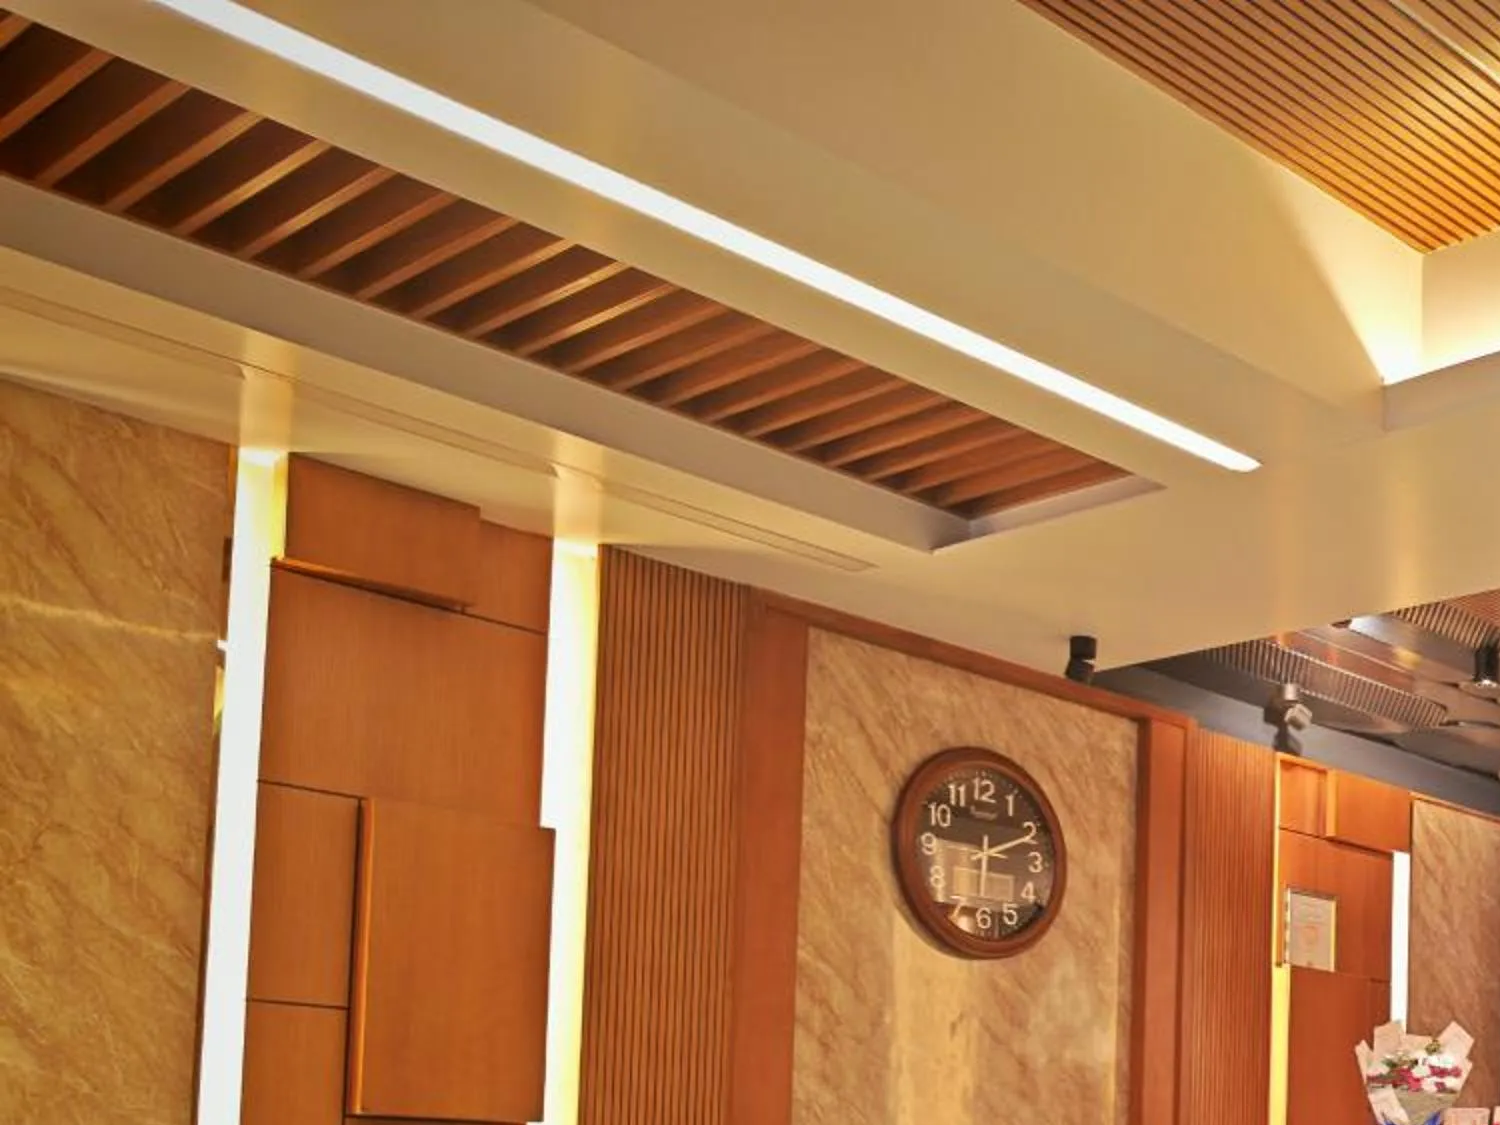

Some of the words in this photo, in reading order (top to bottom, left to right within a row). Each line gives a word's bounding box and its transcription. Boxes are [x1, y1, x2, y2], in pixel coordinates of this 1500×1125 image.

[948, 783, 967, 808] 11
[972, 776, 996, 804] 12
[928, 802, 951, 827] 10
[1005, 793, 1016, 817] 1
[921, 832, 937, 855] 9
[1022, 821, 1038, 844] 2
[1028, 851, 1043, 873] 3
[930, 865, 945, 888] 8
[1020, 880, 1036, 903] 4
[950, 894, 966, 919] 7
[975, 907, 992, 929] 6
[1002, 903, 1018, 925] 5
